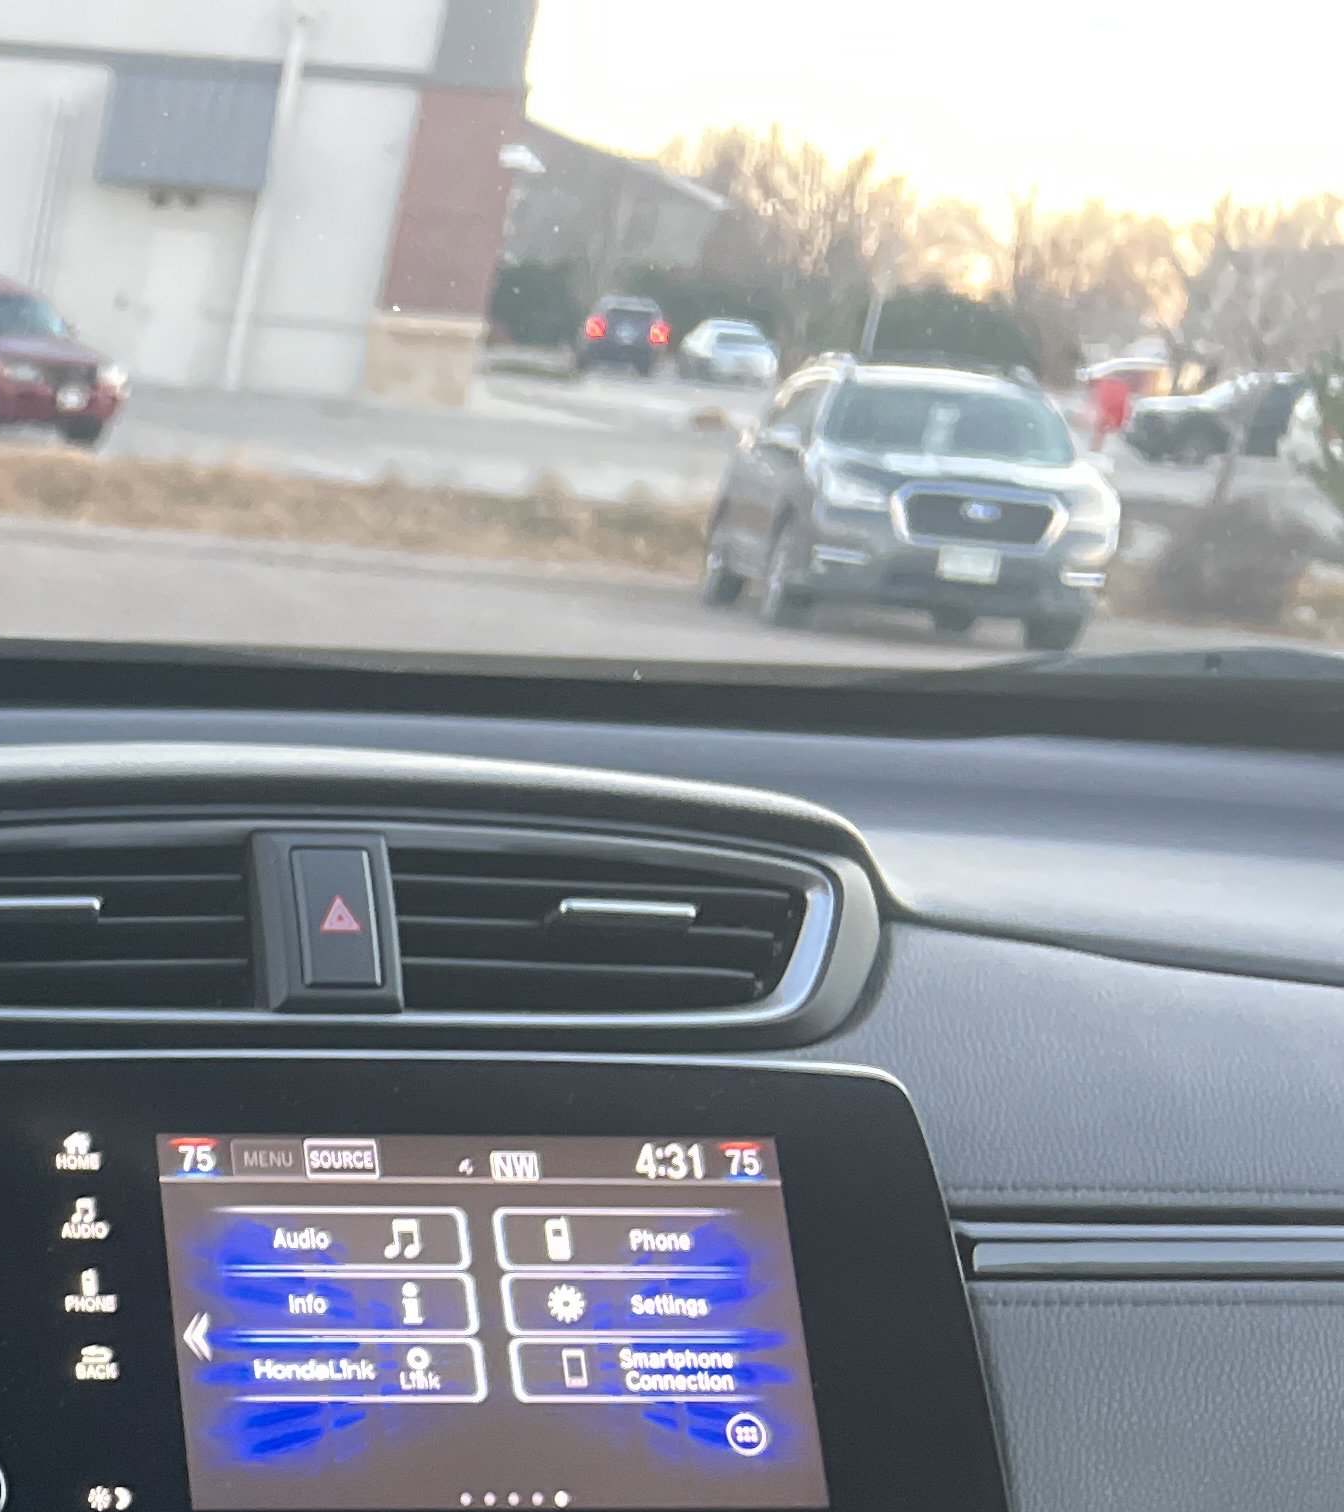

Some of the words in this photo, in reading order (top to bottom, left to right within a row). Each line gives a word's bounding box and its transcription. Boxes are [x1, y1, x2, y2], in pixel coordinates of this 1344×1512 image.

[55, 1152, 102, 1171] HOME
[178, 1145, 216, 1172] 75
[243, 1150, 294, 1168] MENU
[309, 1150, 374, 1170] SOURCE
[493, 1153, 539, 1180] NW
[635, 1142, 705, 1180] 4:31
[725, 1148, 762, 1177] 75
[61, 1222, 110, 1240] AUDIO
[273, 1228, 331, 1250] Audio
[628, 1229, 693, 1251] Phone
[64, 1294, 118, 1313] PHONE
[288, 1294, 329, 1316] Info
[630, 1294, 710, 1317] Settings
[619, 1348, 736, 1371] Smartphone
[75, 1363, 120, 1381] BACK
[399, 1371, 441, 1391] Link
[625, 1371, 735, 1392] Connection
